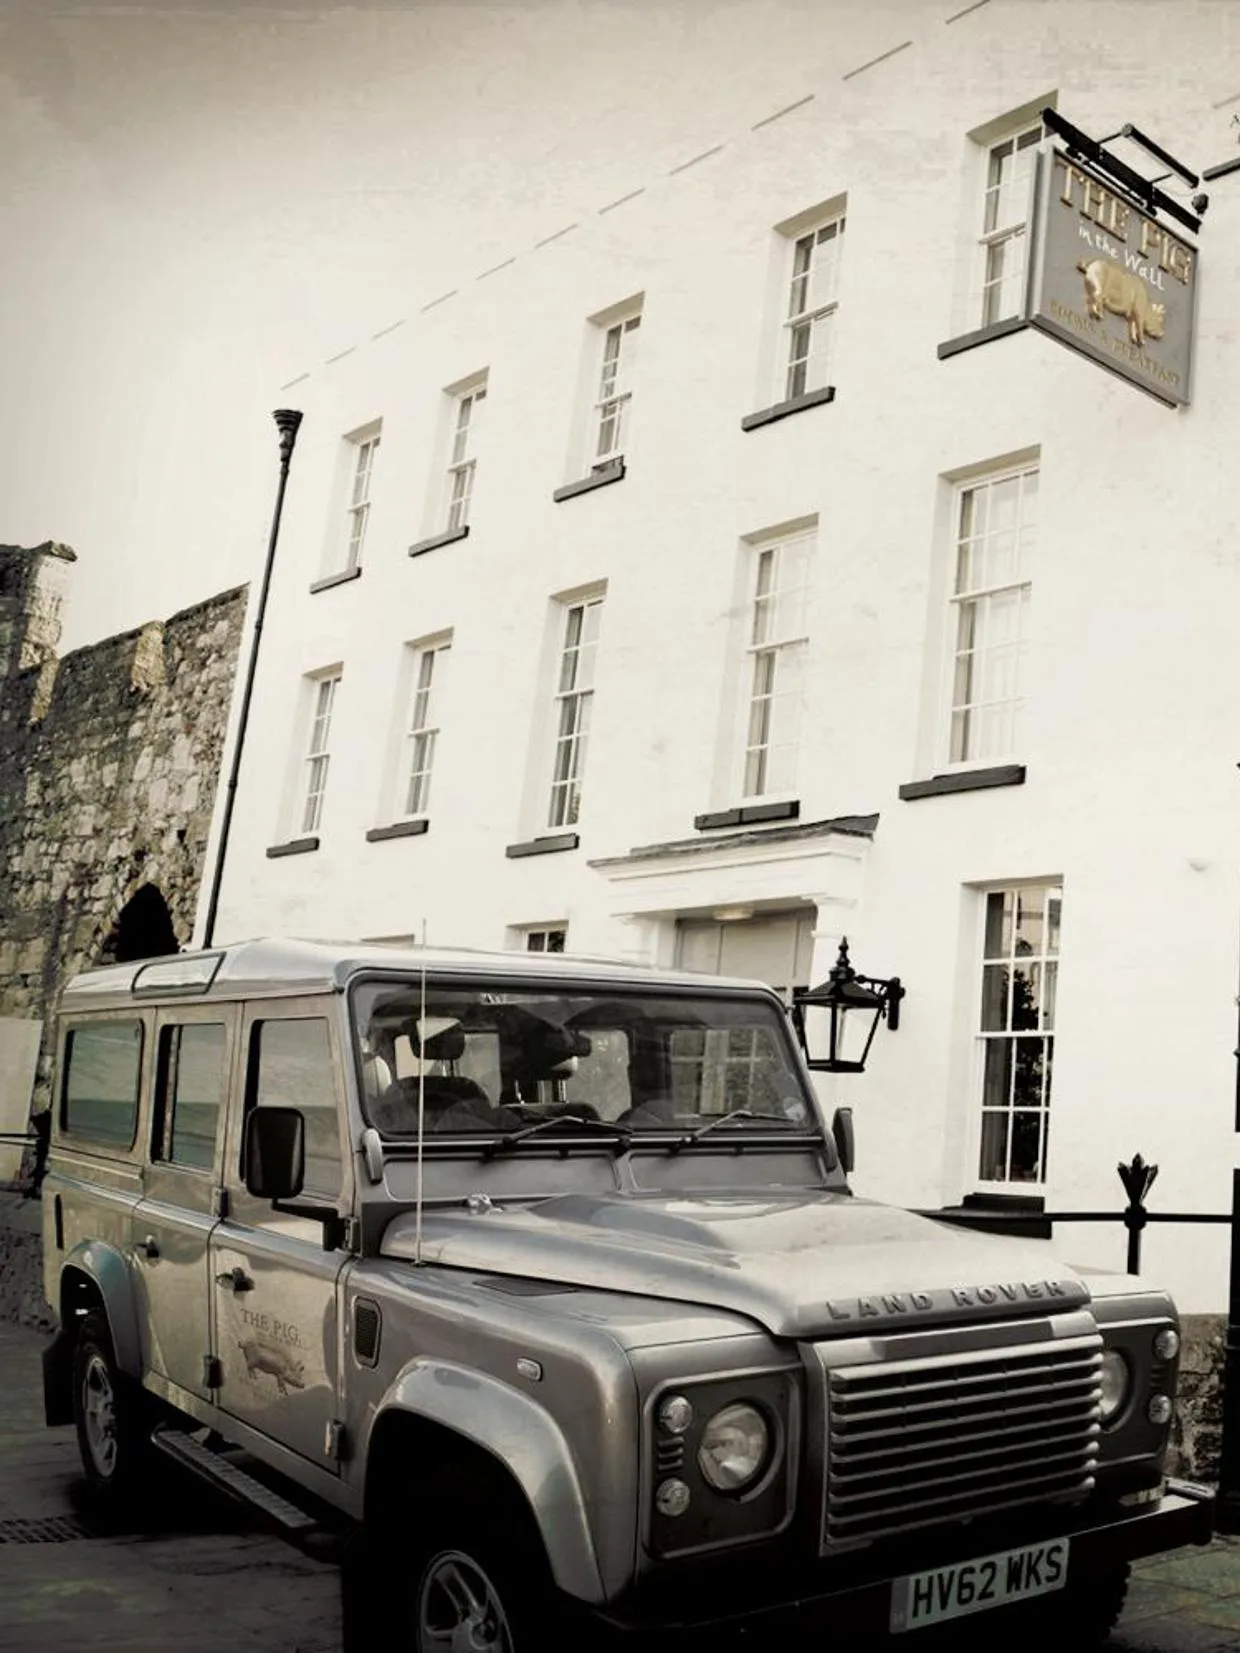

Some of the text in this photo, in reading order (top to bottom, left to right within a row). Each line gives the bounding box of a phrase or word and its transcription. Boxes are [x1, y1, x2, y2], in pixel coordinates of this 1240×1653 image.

[1055, 160, 1192, 286] THE PIG
[1079, 220, 1166, 291] in the Wall
[240, 1308, 269, 1332] THE
[272, 1320, 299, 1342] PIG
[825, 1279, 1067, 1321] LAND ROVER
[911, 1544, 1064, 1620] HV62 WKS
